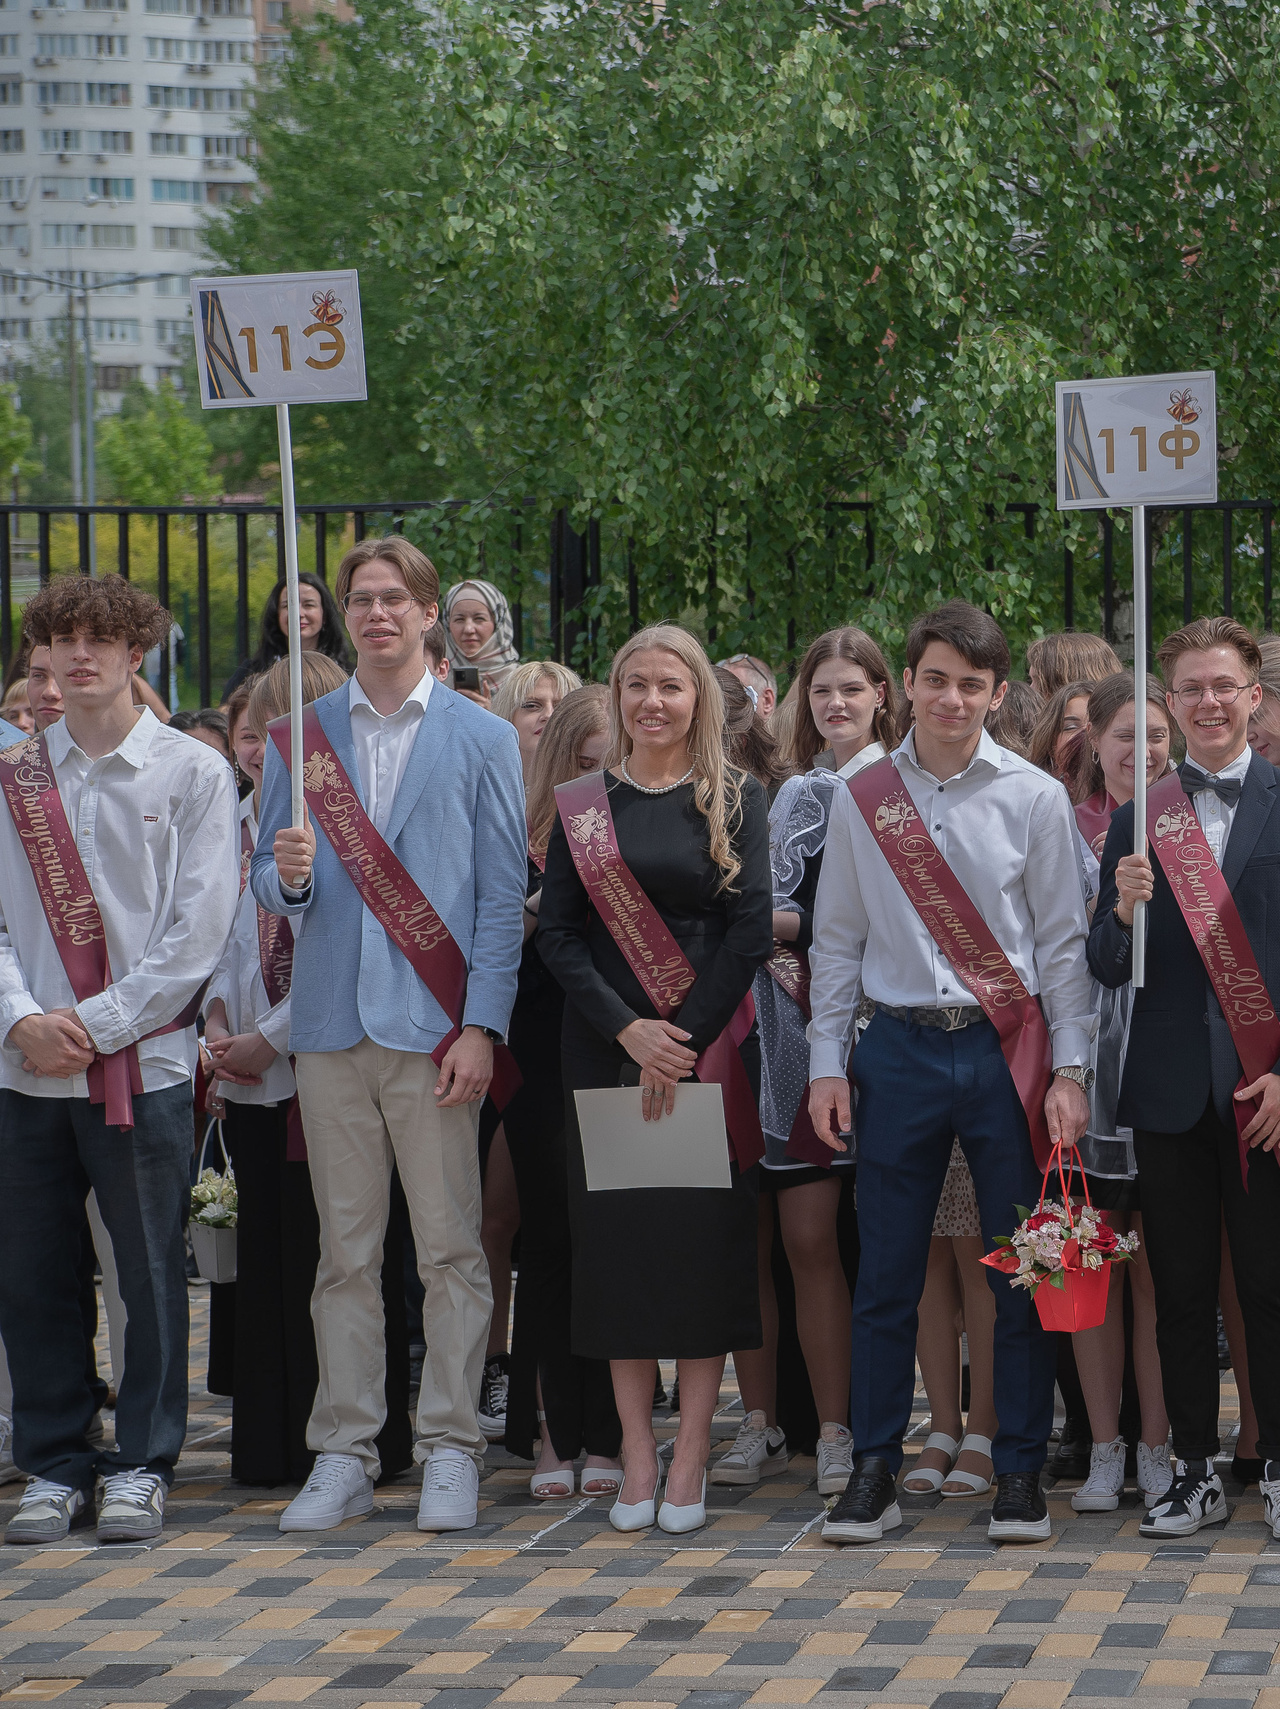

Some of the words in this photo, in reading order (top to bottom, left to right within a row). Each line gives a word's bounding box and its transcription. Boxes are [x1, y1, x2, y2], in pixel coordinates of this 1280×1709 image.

[238, 322, 345, 373] 11Э
[1097, 424, 1200, 474] 11Ф
[14, 765, 72, 897] Выпускник
[57, 894, 104, 946] 2023
[323, 789, 405, 910] Выпускник
[394, 900, 449, 950] 2023
[595, 843, 643, 914] Классный
[591, 878, 654, 962] руководитель
[897, 834, 980, 957] Выпускник
[964, 952, 1027, 1007] 2023
[1175, 843, 1237, 970] Выпускник
[1221, 968, 1274, 1025] 2023
